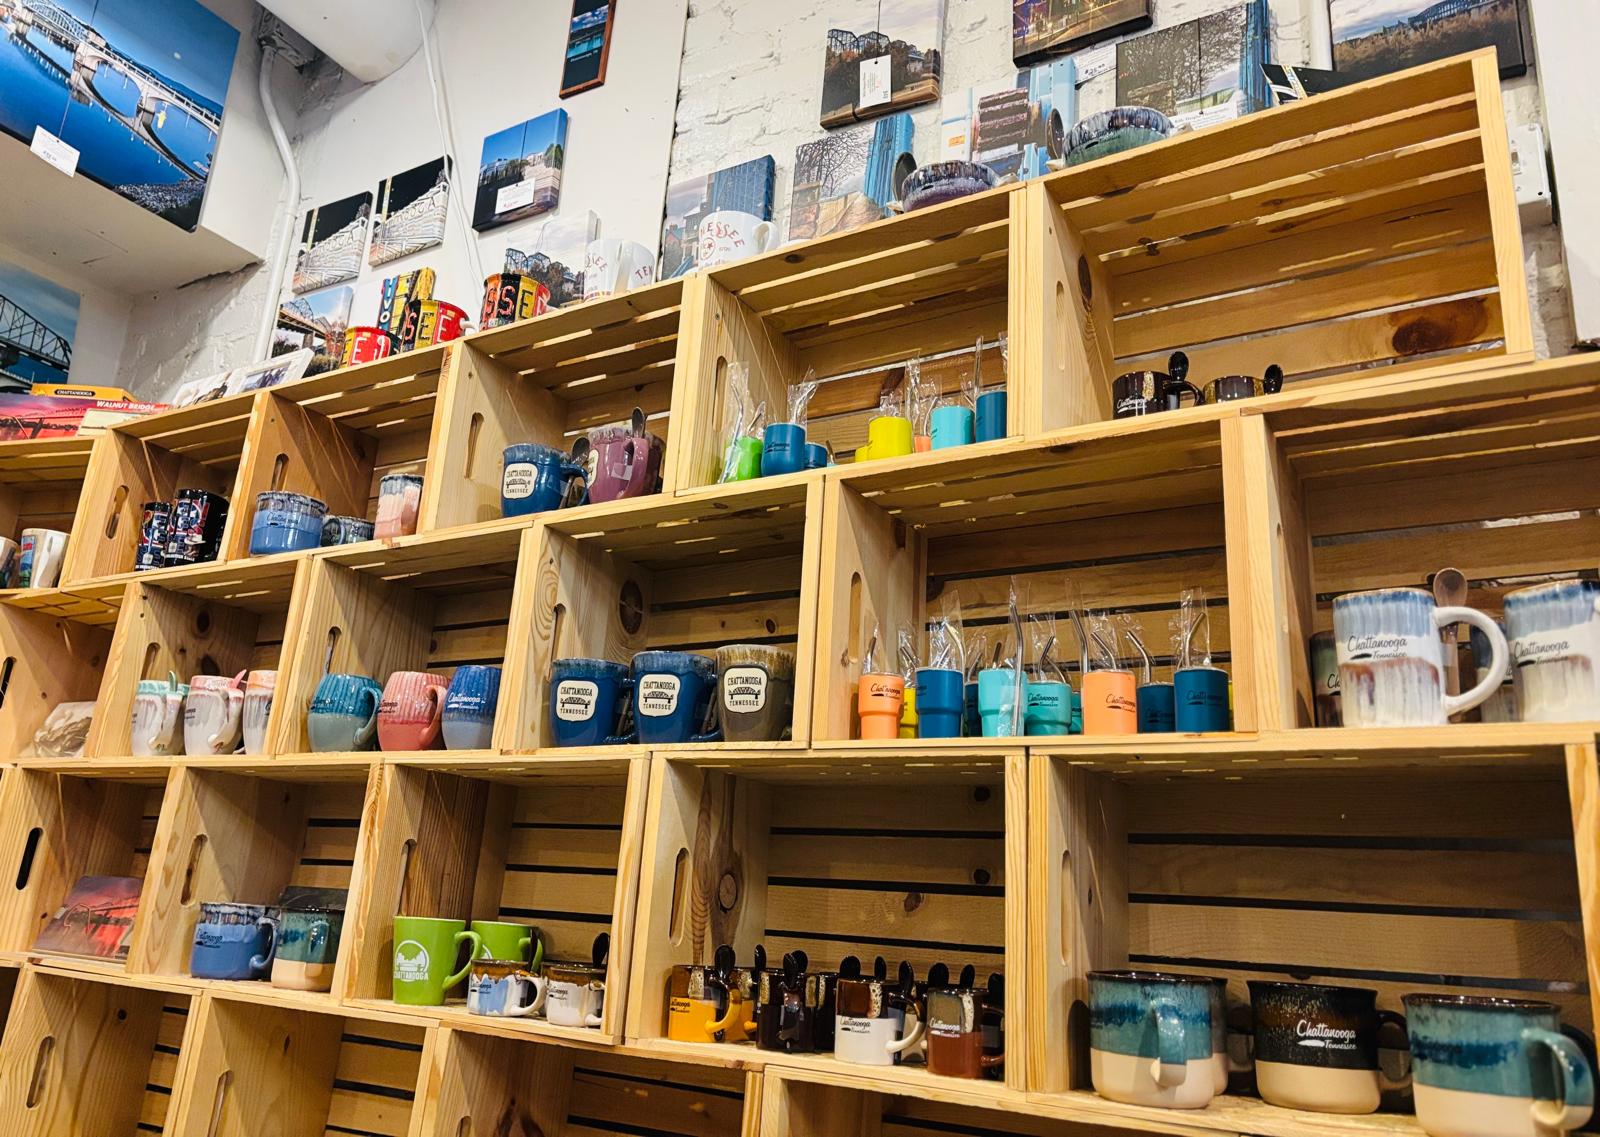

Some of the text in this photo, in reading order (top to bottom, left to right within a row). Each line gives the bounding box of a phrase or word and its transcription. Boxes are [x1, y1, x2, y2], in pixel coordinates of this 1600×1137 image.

[96, 400, 127, 409] WALNUT
[128, 402, 155, 411] BRIDGE
[1348, 635, 1407, 652] Chattanooga
[1373, 650, 1407, 659] Tennessee
[1514, 641, 1569, 660] Chattanooga
[643, 680, 676, 691] CHATTANOOGA
[727, 675, 762, 686] CHATTANOOGA
[560, 686, 593, 697] CHATTANOOGA
[729, 699, 759, 707] TENNESSEE
[560, 708, 589, 716] TENNESSEE
[1296, 1019, 1356, 1044] Chattanooga
[1324, 1040, 1357, 1050] Tennessee
